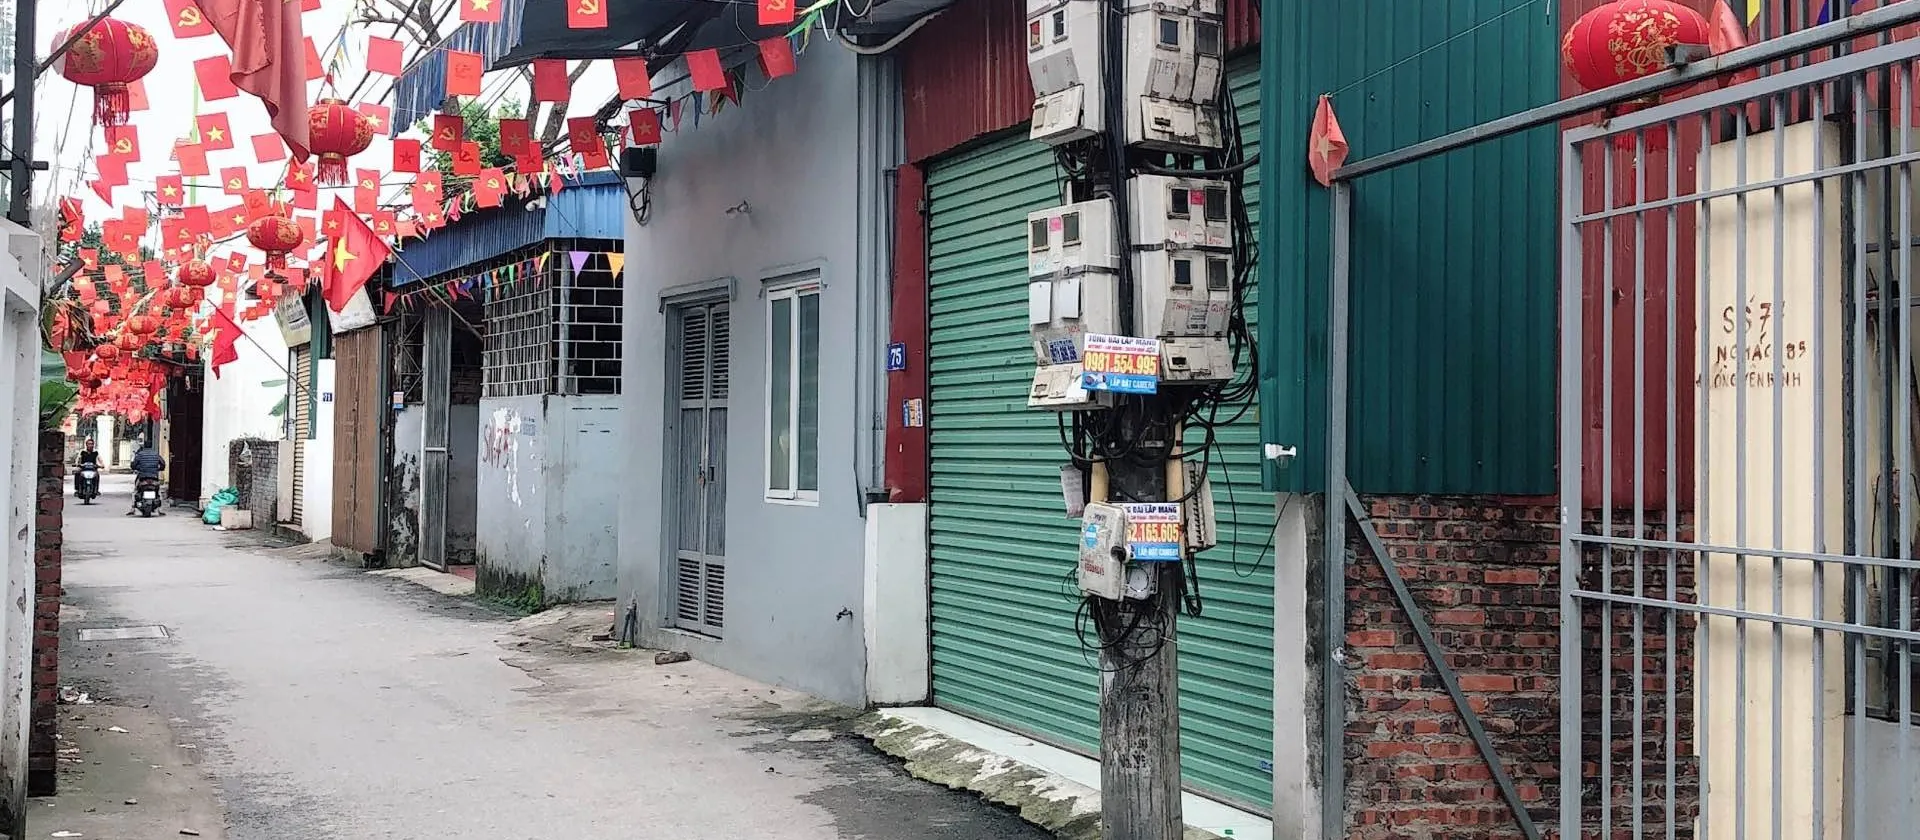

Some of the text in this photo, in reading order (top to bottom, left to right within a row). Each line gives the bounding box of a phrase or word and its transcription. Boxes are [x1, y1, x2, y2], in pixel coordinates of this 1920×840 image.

[1759, 300, 1785, 332] 7
[890, 348, 902, 365] 75
[1786, 341, 1806, 360] 85
[1085, 351, 1157, 375] 0981.554.995
[1132, 380, 1156, 389] CAMERA
